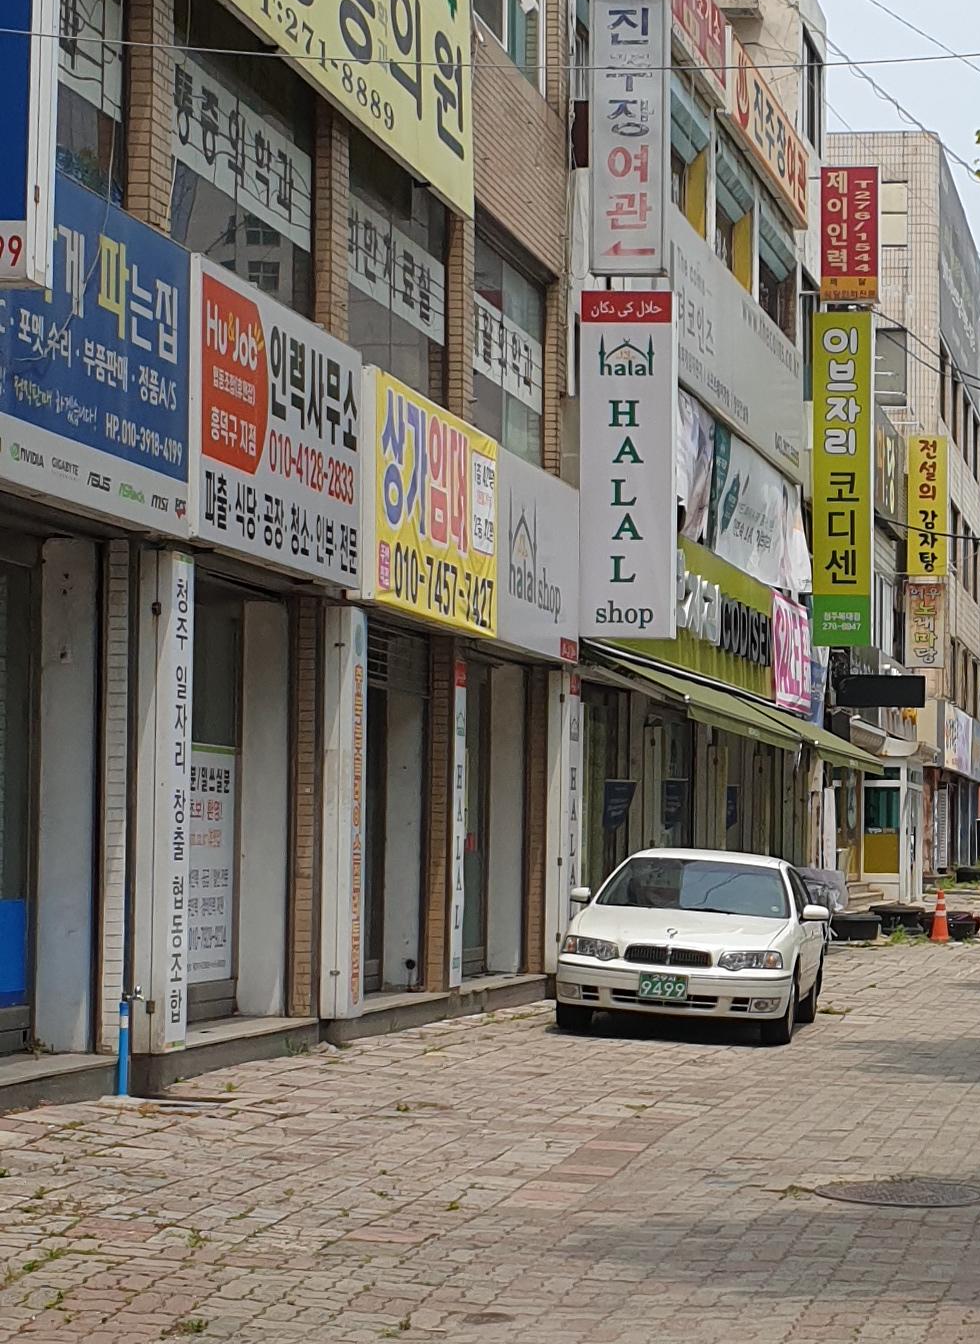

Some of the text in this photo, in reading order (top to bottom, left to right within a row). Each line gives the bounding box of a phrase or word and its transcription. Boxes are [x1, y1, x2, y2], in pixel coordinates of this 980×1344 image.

[174, 65, 292, 223] 통증의학과
[752, 78, 806, 216] 진주장여관
[826, 170, 848, 273] 제이인력
[206, 299, 258, 371] Hu&Job
[270, 325, 358, 453] 인력사무소
[821, 326, 861, 456] 이브자리
[51, 457, 79, 476] GIGABYTE
[87, 471, 112, 492] ASUS
[269, 429, 354, 505] 010-4128-2833
[381, 389, 469, 554] 상가임대
[608, 399, 645, 584] HALAL
[918, 439, 938, 501] 전설의
[824, 471, 861, 585] 코디센
[918, 509, 938, 573] 감자탕
[394, 542, 494, 630] 010-7457-7427
[537, 567, 562, 624] shop
[595, 601, 654, 628] shop
[912, 600, 938, 664] 노래마당
[169, 579, 189, 1025] 청주 일자리 창출 협동조합
[641, 979, 687, 999] 9499
